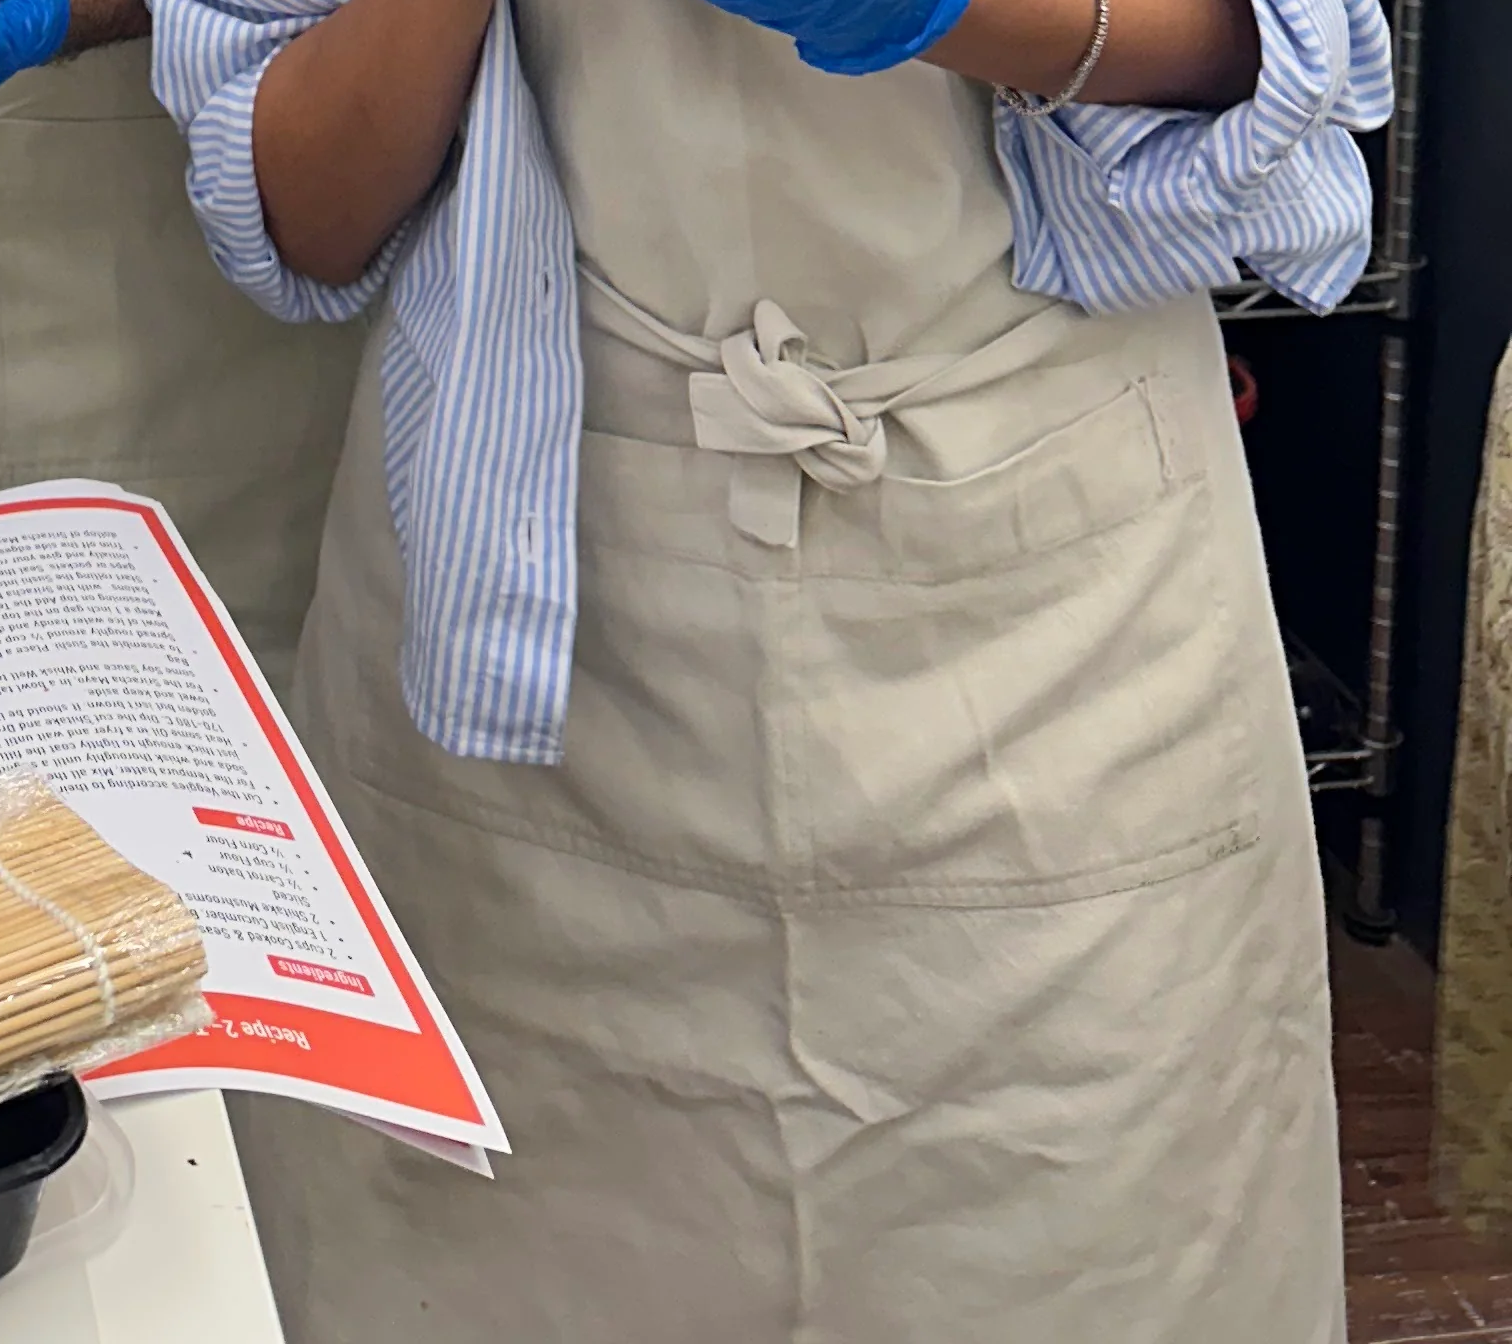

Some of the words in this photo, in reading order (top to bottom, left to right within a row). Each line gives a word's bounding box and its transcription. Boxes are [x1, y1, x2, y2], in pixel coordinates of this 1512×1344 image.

[160, 767, 212, 782] Tempura
[214, 774, 233, 786] the
[58, 783, 88, 794] their
[92, 782, 104, 791] to
[107, 779, 168, 790] according
[172, 780, 219, 796] Veggies
[237, 778, 255, 789] For
[222, 790, 239, 801] the
[242, 793, 262, 805] Cut
[236, 816, 285, 837] Recipe
[206, 836, 237, 849] Flour
[240, 841, 268, 855] Corn
[219, 852, 252, 866] Flour
[254, 856, 276, 870] cup
[208, 864, 244, 878] baton
[248, 871, 285, 887] Carrot
[185, 893, 259, 911] Mushrooms
[273, 891, 310, 907] Sliced
[262, 904, 307, 922] Shitake
[310, 913, 319, 924] 2
[271, 917, 317, 938] English
[234, 931, 244, 941] &
[248, 931, 293, 948] Cooked
[295, 939, 325, 955] cups
[329, 948, 336, 959] 2
[278, 960, 364, 992] Ingredients
[241, 1019, 311, 1051] Recipe
